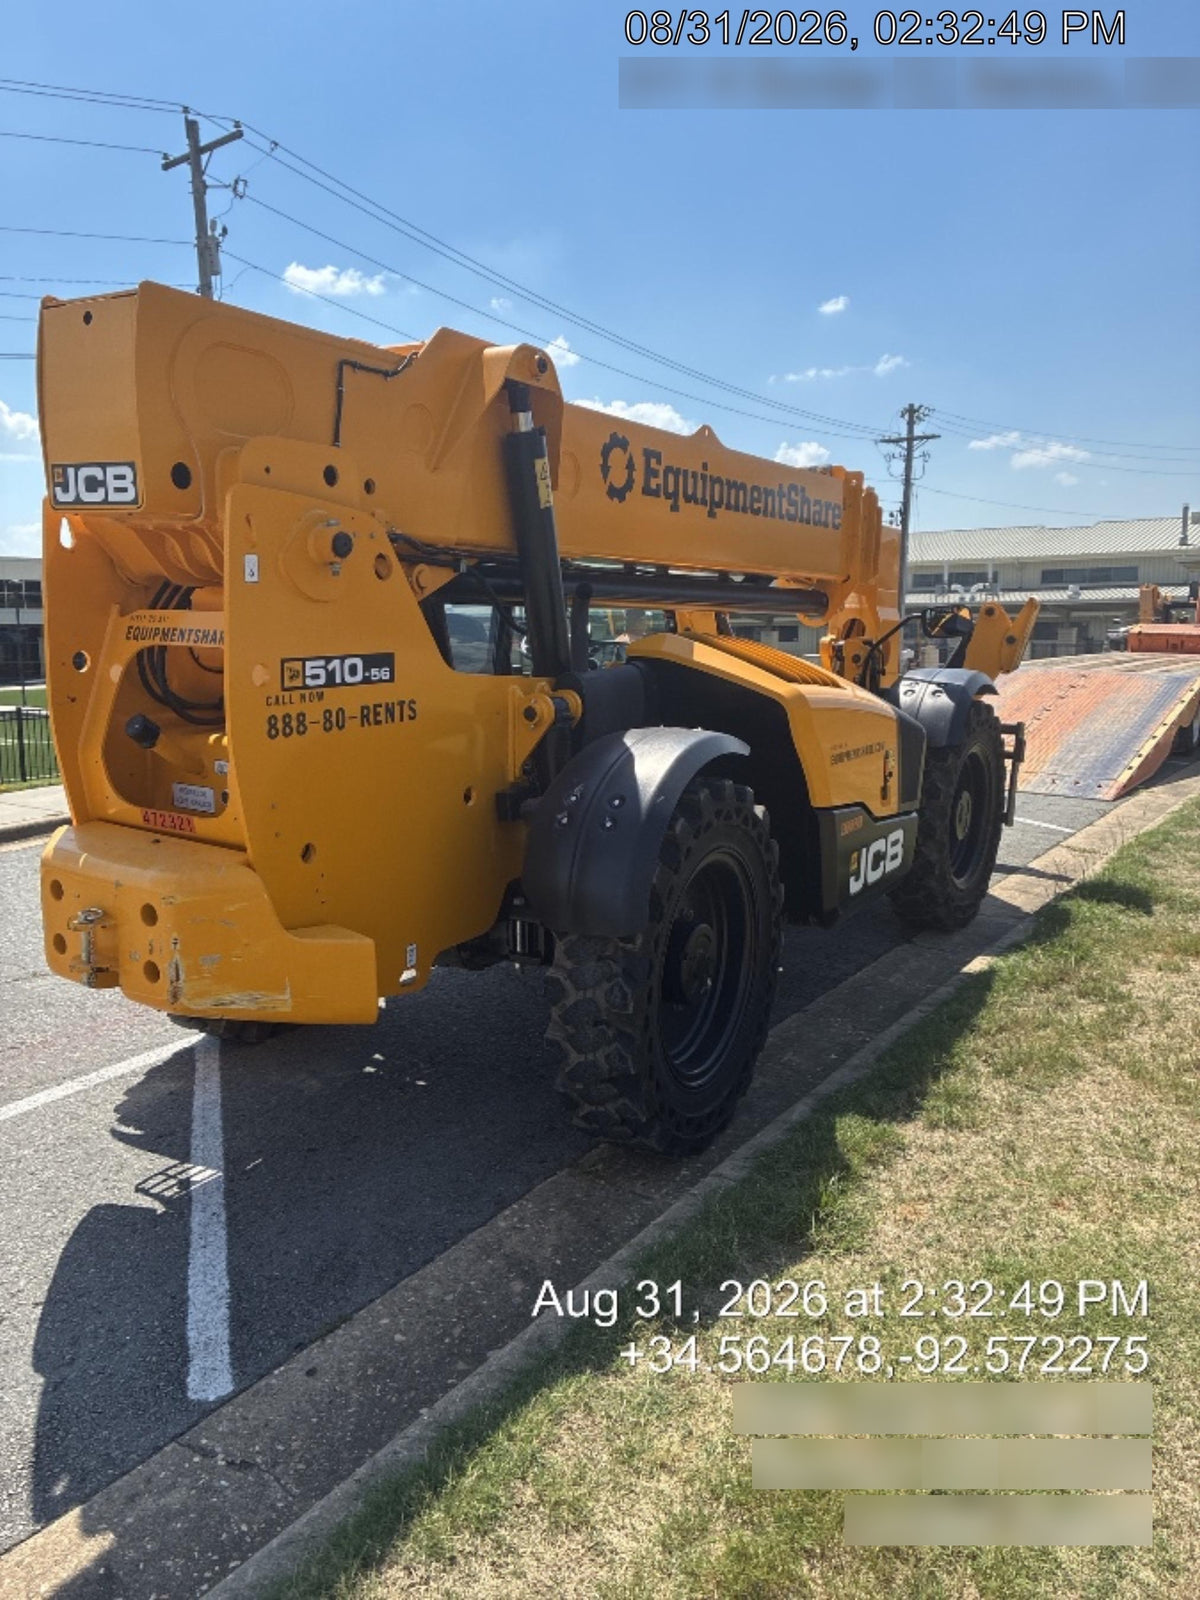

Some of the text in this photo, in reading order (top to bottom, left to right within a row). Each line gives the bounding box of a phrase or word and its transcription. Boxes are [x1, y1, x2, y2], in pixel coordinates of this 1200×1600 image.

[54, 465, 136, 502] JCB
[641, 447, 843, 530] EquipmentShare
[305, 657, 390, 686] 510-56
[266, 691, 325, 707] CALL NOW
[267, 698, 417, 740] 888-80-RENTS
[849, 828, 904, 896] JCB
